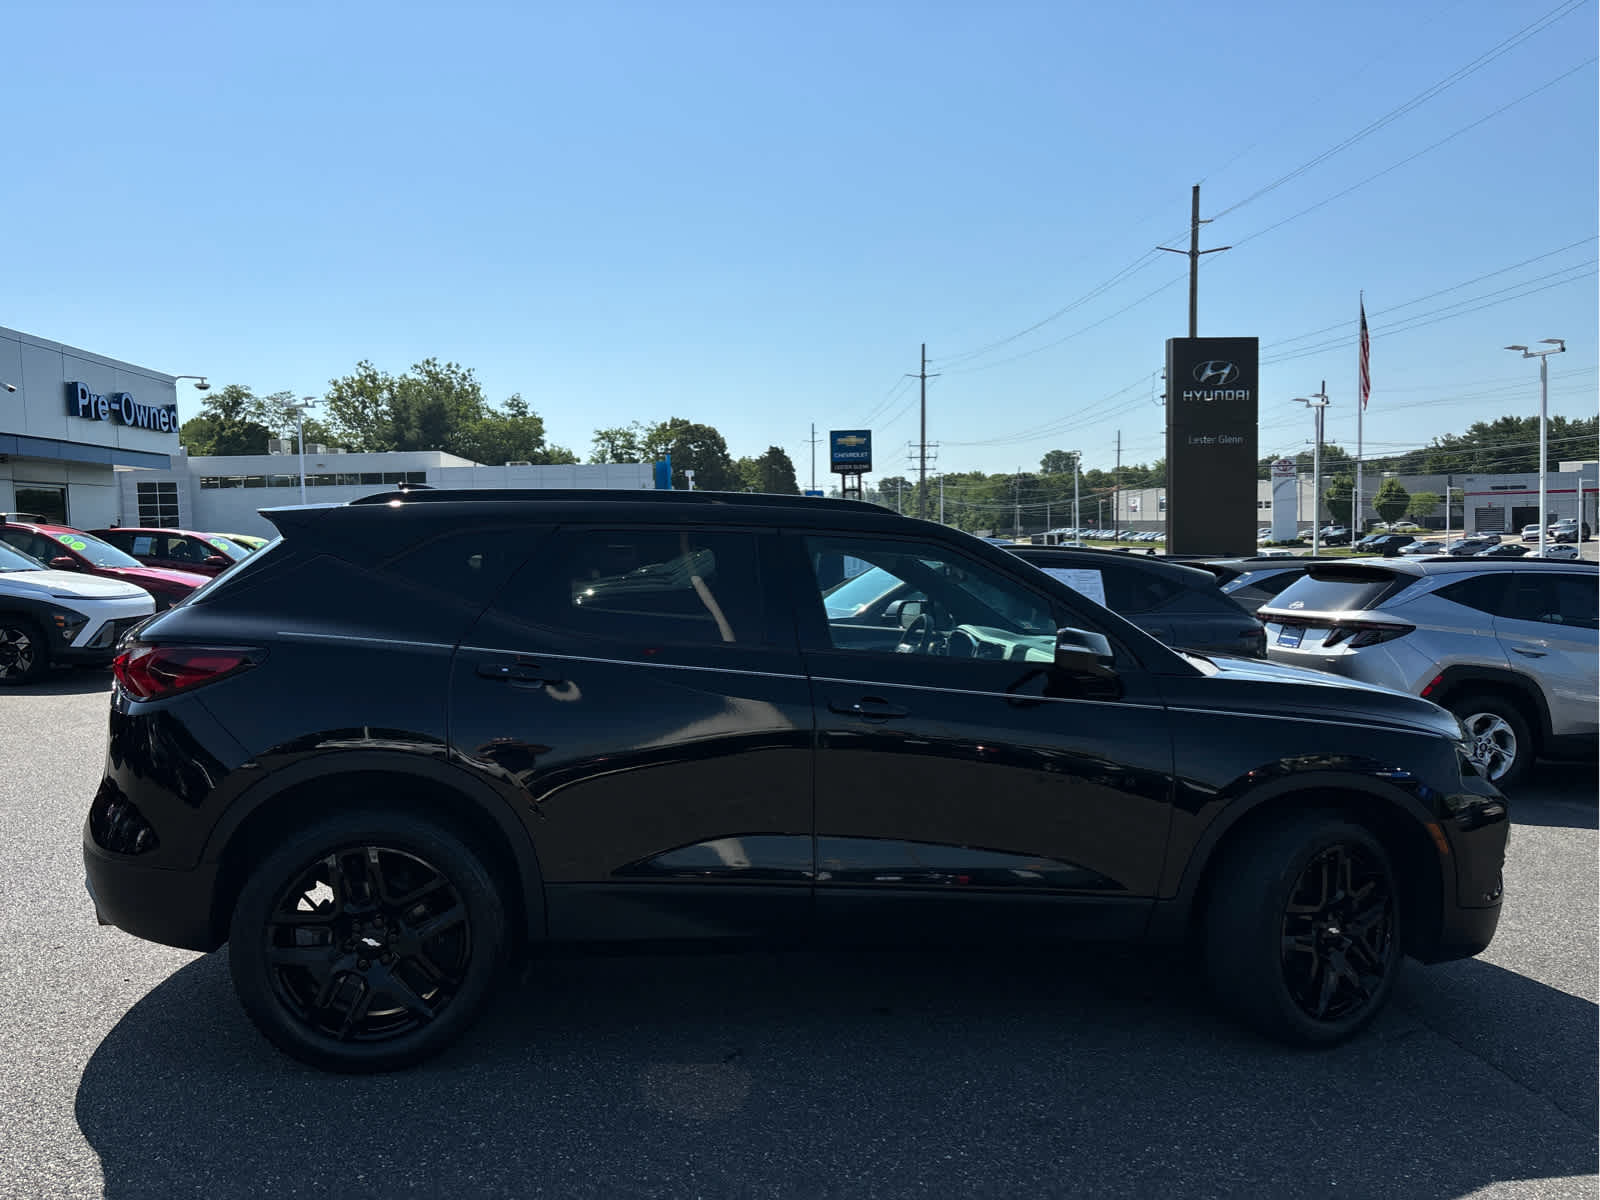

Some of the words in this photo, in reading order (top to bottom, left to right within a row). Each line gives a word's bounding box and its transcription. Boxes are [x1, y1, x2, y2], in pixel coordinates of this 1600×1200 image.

[1183, 389, 1250, 401] HYUNDAI
[76, 381, 179, 433] Pre-Owned
[1188, 434, 1216, 445] Lester
[1218, 434, 1244, 445] Glenn
